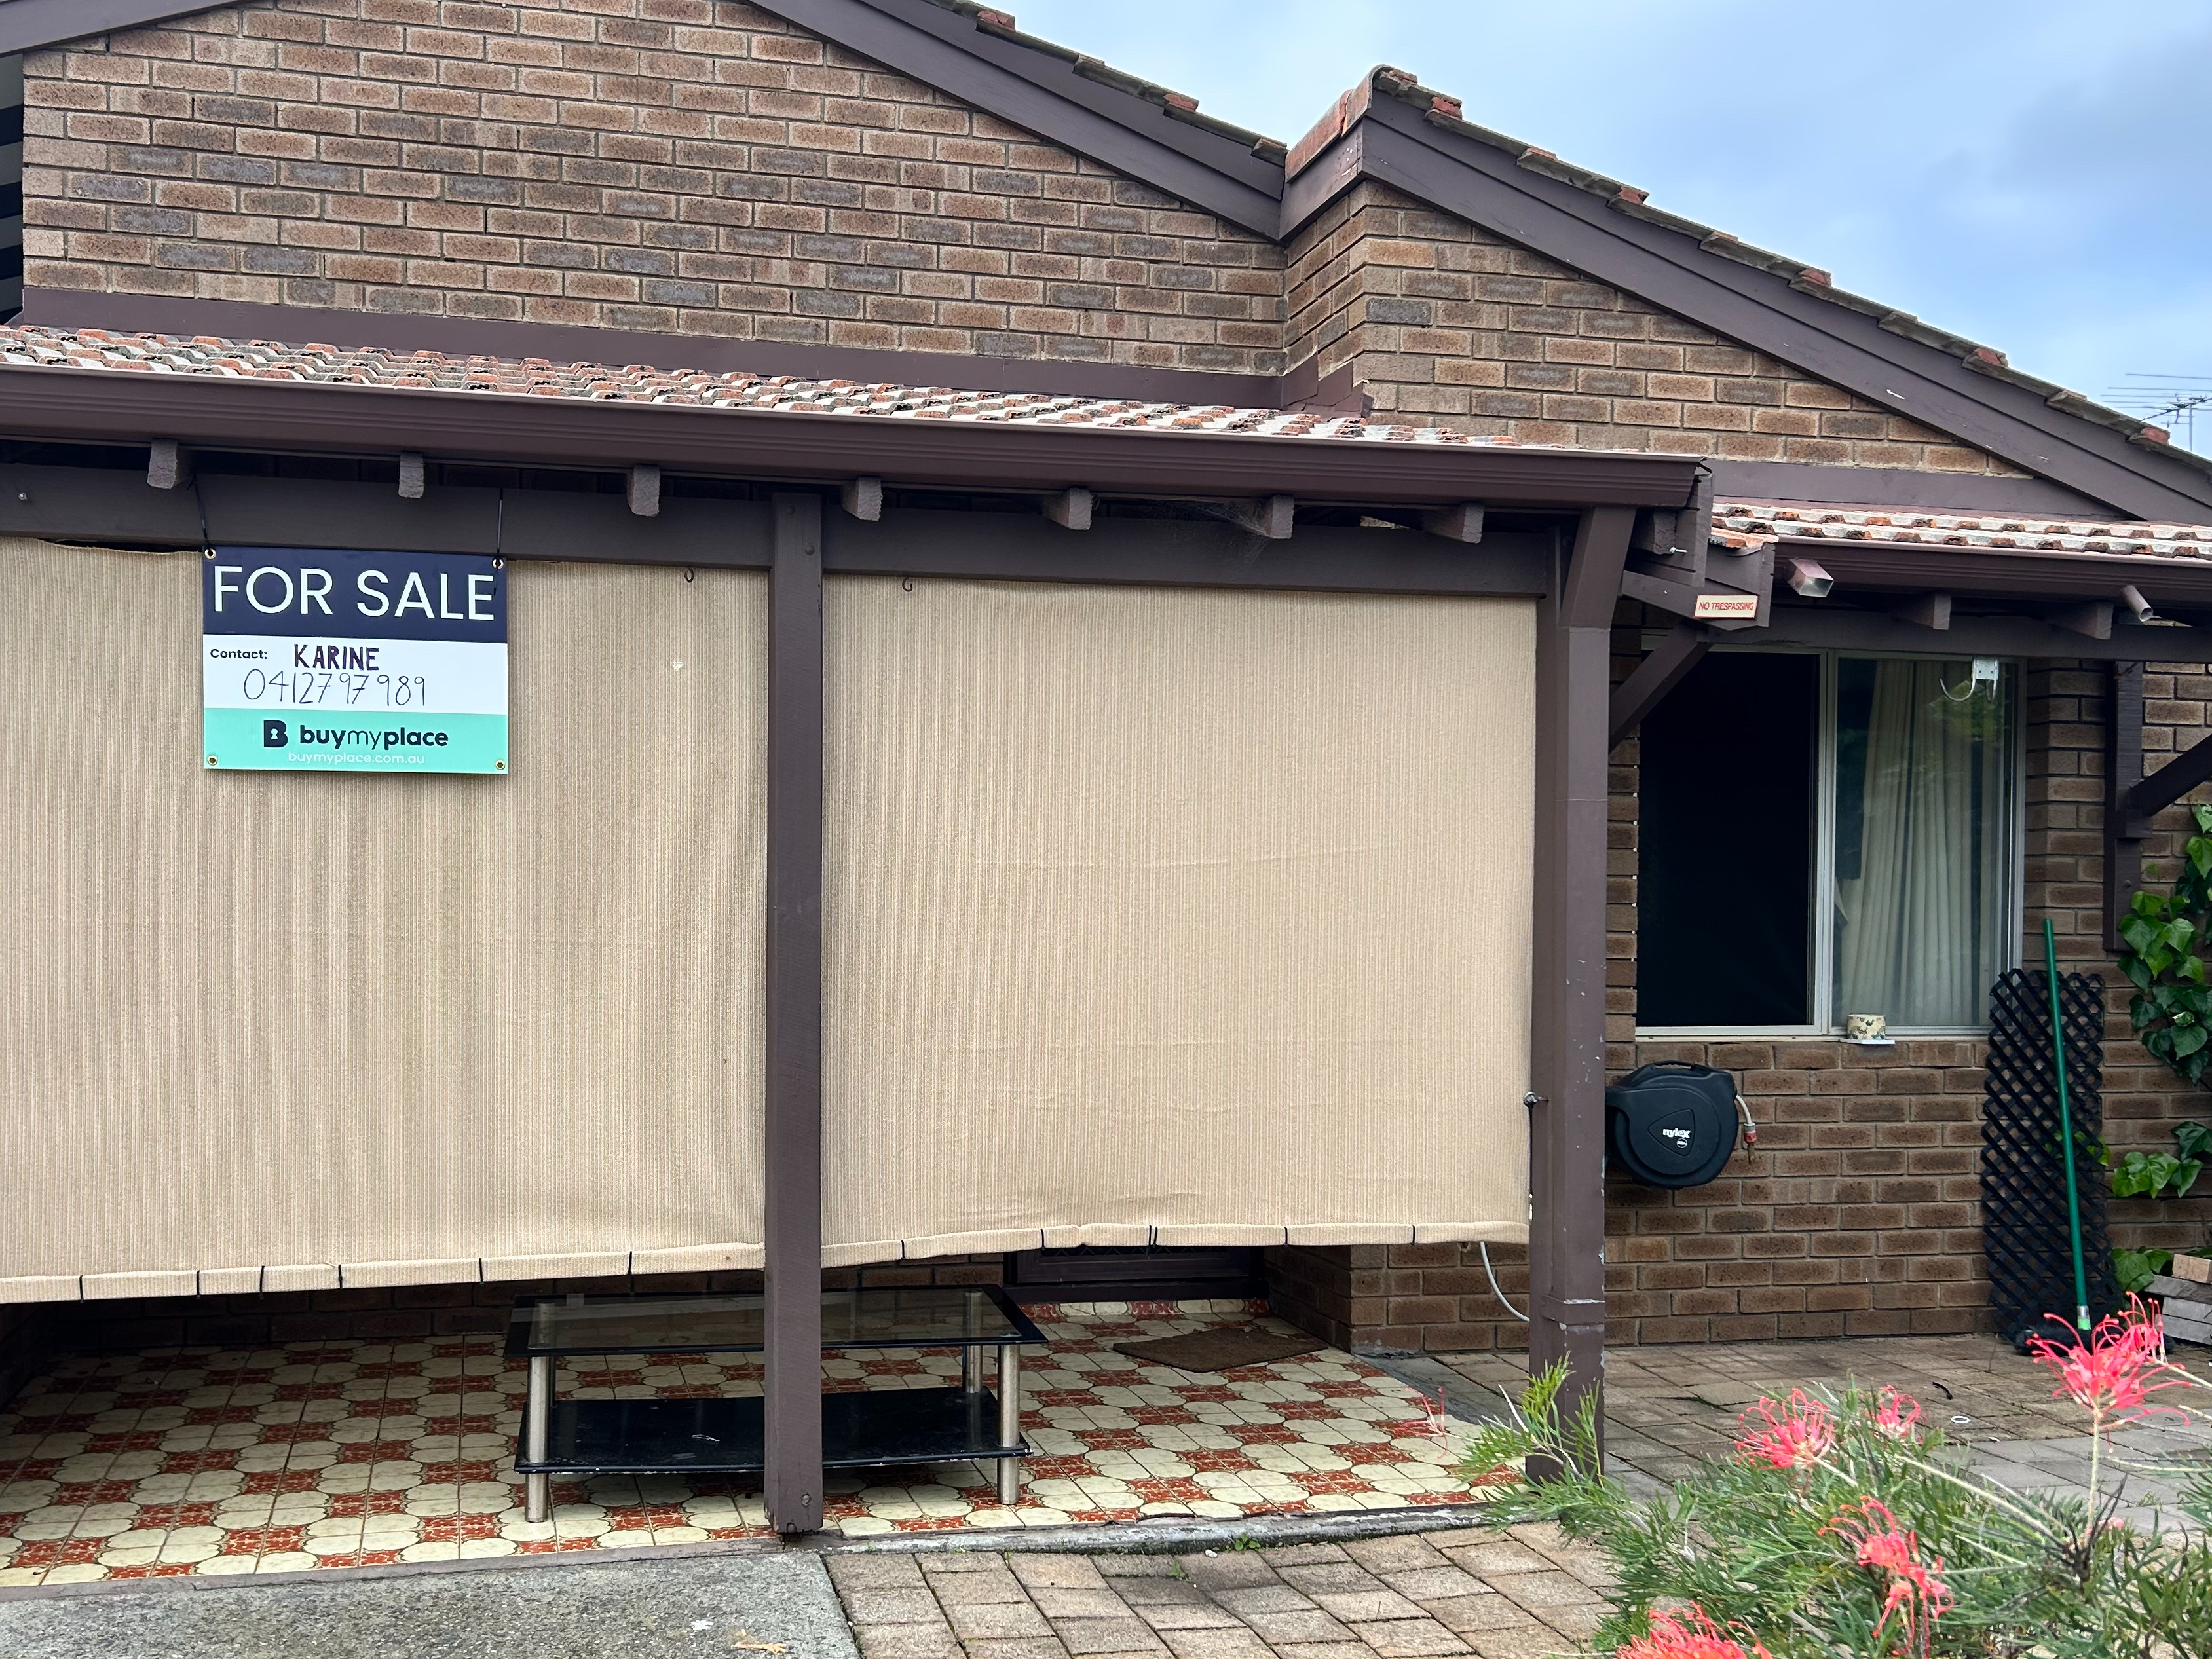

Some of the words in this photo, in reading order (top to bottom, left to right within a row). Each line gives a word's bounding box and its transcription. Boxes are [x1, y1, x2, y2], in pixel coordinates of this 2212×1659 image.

[214, 565, 333, 615] FOR
[356, 570, 495, 621] SALE
[1698, 602, 1710, 610] NO
[1712, 602, 1754, 610] TRESPASSING
[210, 648, 268, 660] Contact:
[294, 643, 380, 671] KARINE
[244, 668, 426, 707] 0412797989
[299, 724, 449, 751] buymyplace
[288, 751, 425, 765] buymyplace.com.au
[1662, 1128, 1691, 1139] nylex
